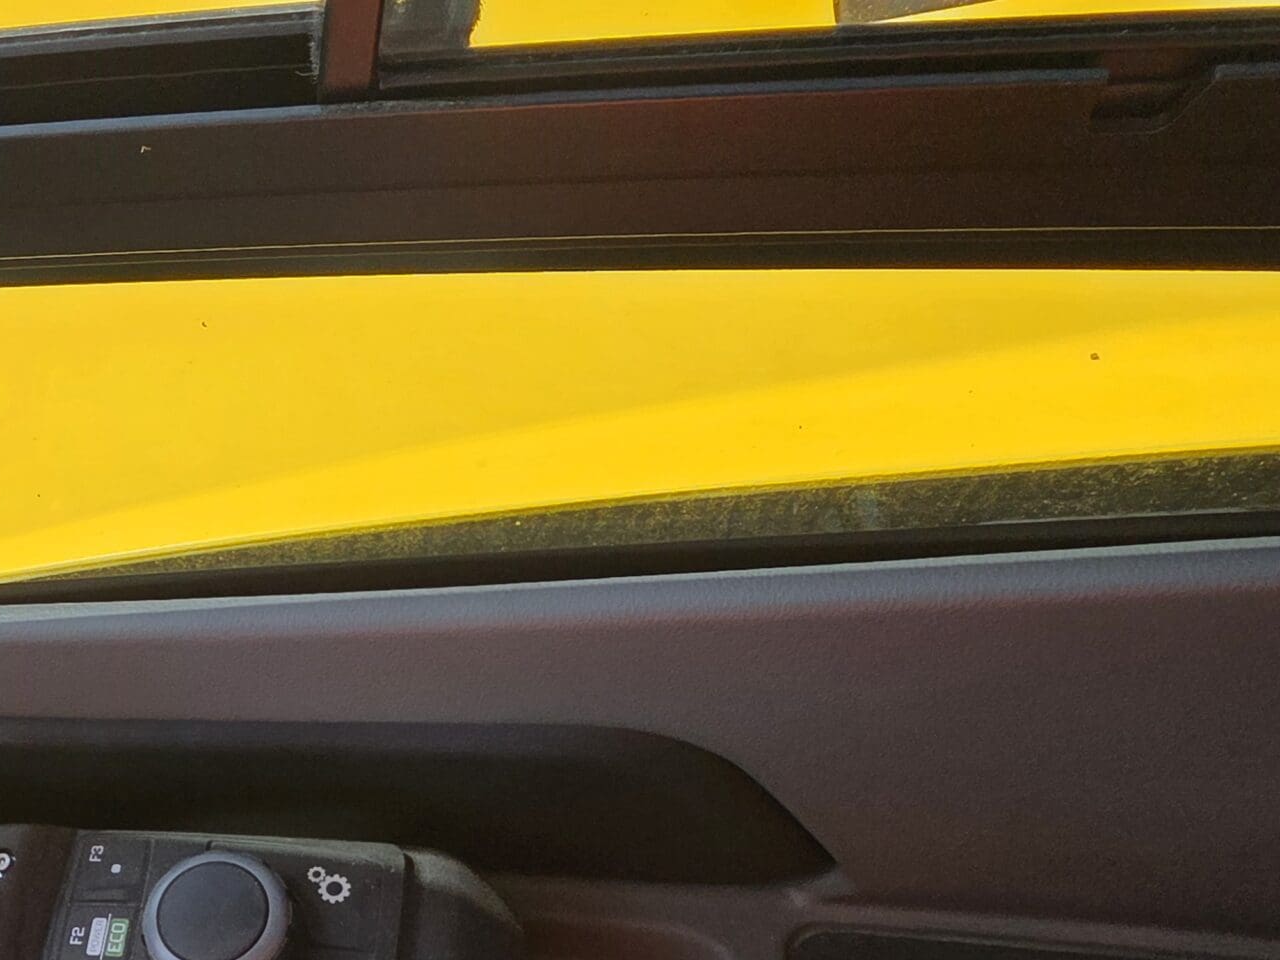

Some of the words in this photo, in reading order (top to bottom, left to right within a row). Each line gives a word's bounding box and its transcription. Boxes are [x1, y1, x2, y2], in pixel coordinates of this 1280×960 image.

[89, 845, 104, 862] F3
[69, 926, 85, 945] F2
[107, 922, 127, 954] ECO
